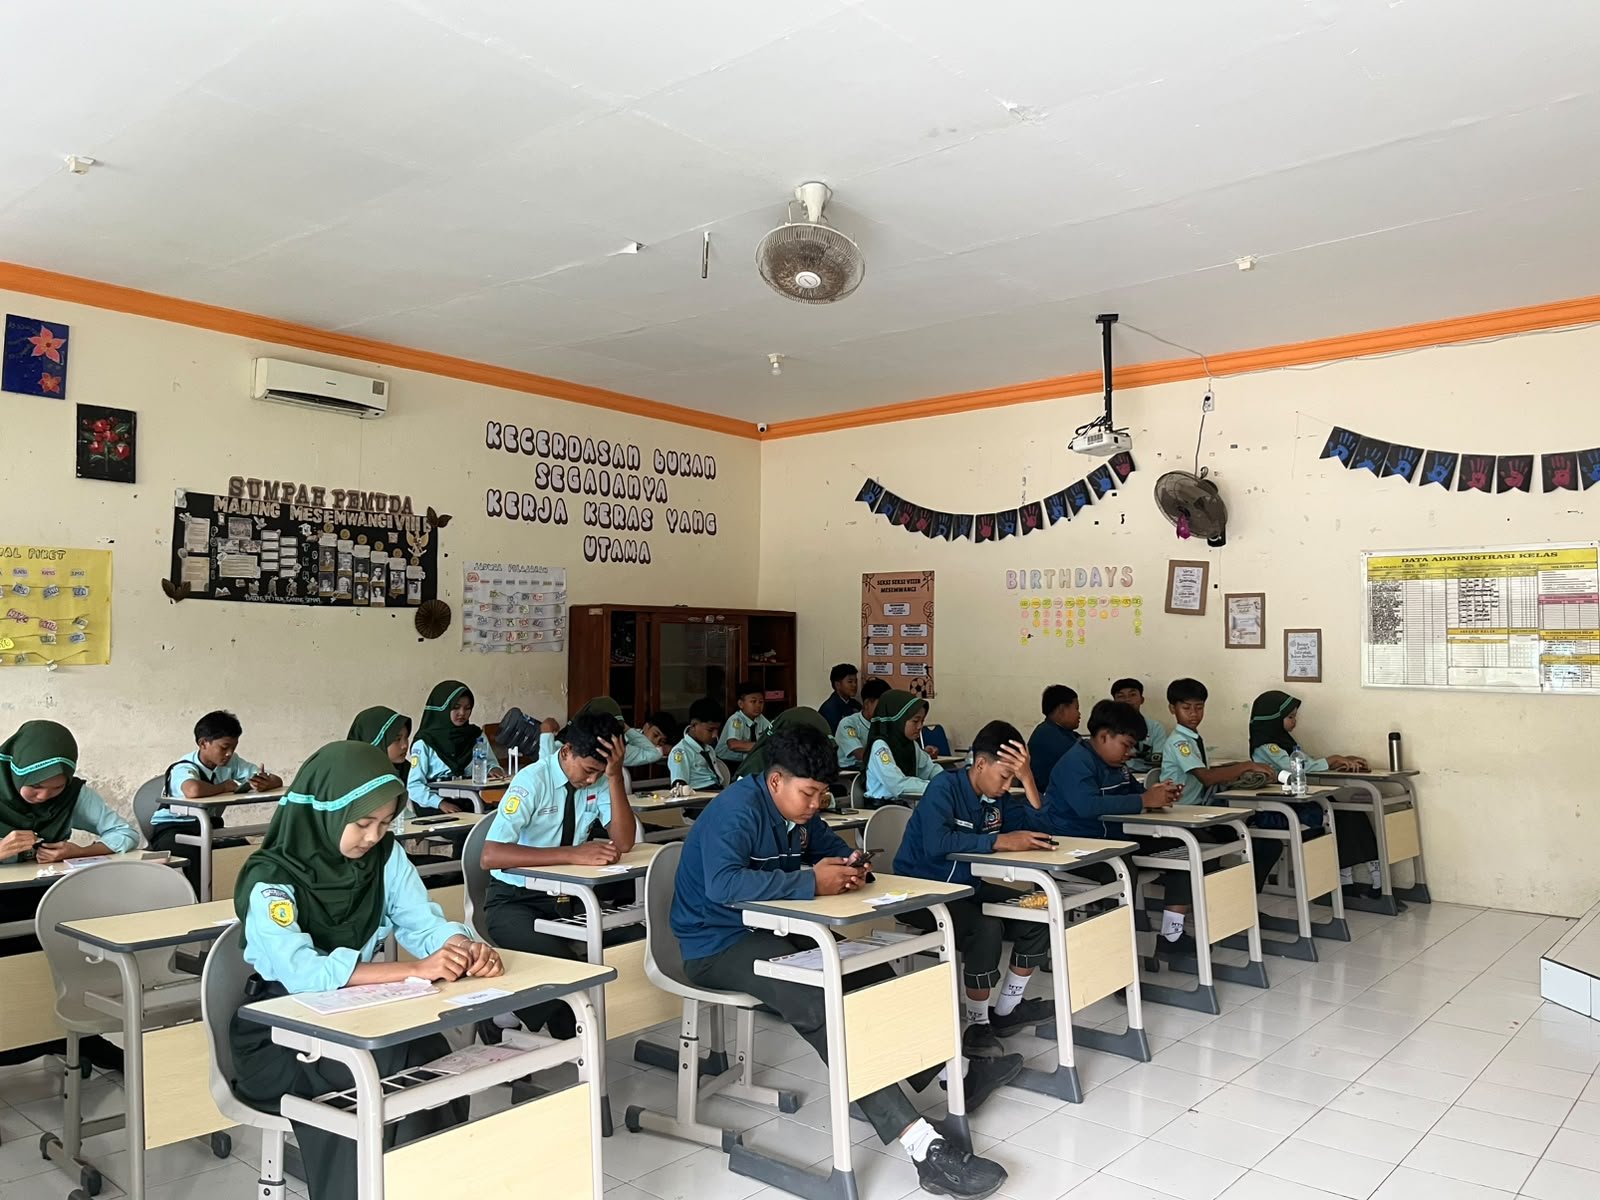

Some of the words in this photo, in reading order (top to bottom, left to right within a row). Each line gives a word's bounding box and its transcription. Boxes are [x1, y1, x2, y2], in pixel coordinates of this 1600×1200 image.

[485, 420, 641, 471] KECERDASAN
[228, 476, 326, 507] SUMPAH
[330, 488, 414, 515] PEMUDA
[213, 495, 281, 519] MADING
[289, 504, 394, 530] MESEMWANGI
[486, 489, 568, 524] KERJA
[583, 501, 653, 531] KERAS
[666, 507, 717, 536] YANG
[0, 547, 22, 559] AL
[28, 548, 66, 561] PIKET
[583, 535, 652, 564] UTAMA
[1431, 553, 1516, 562] ADMINISTRASI
[1005, 565, 1134, 590] BIRTHDAYS
